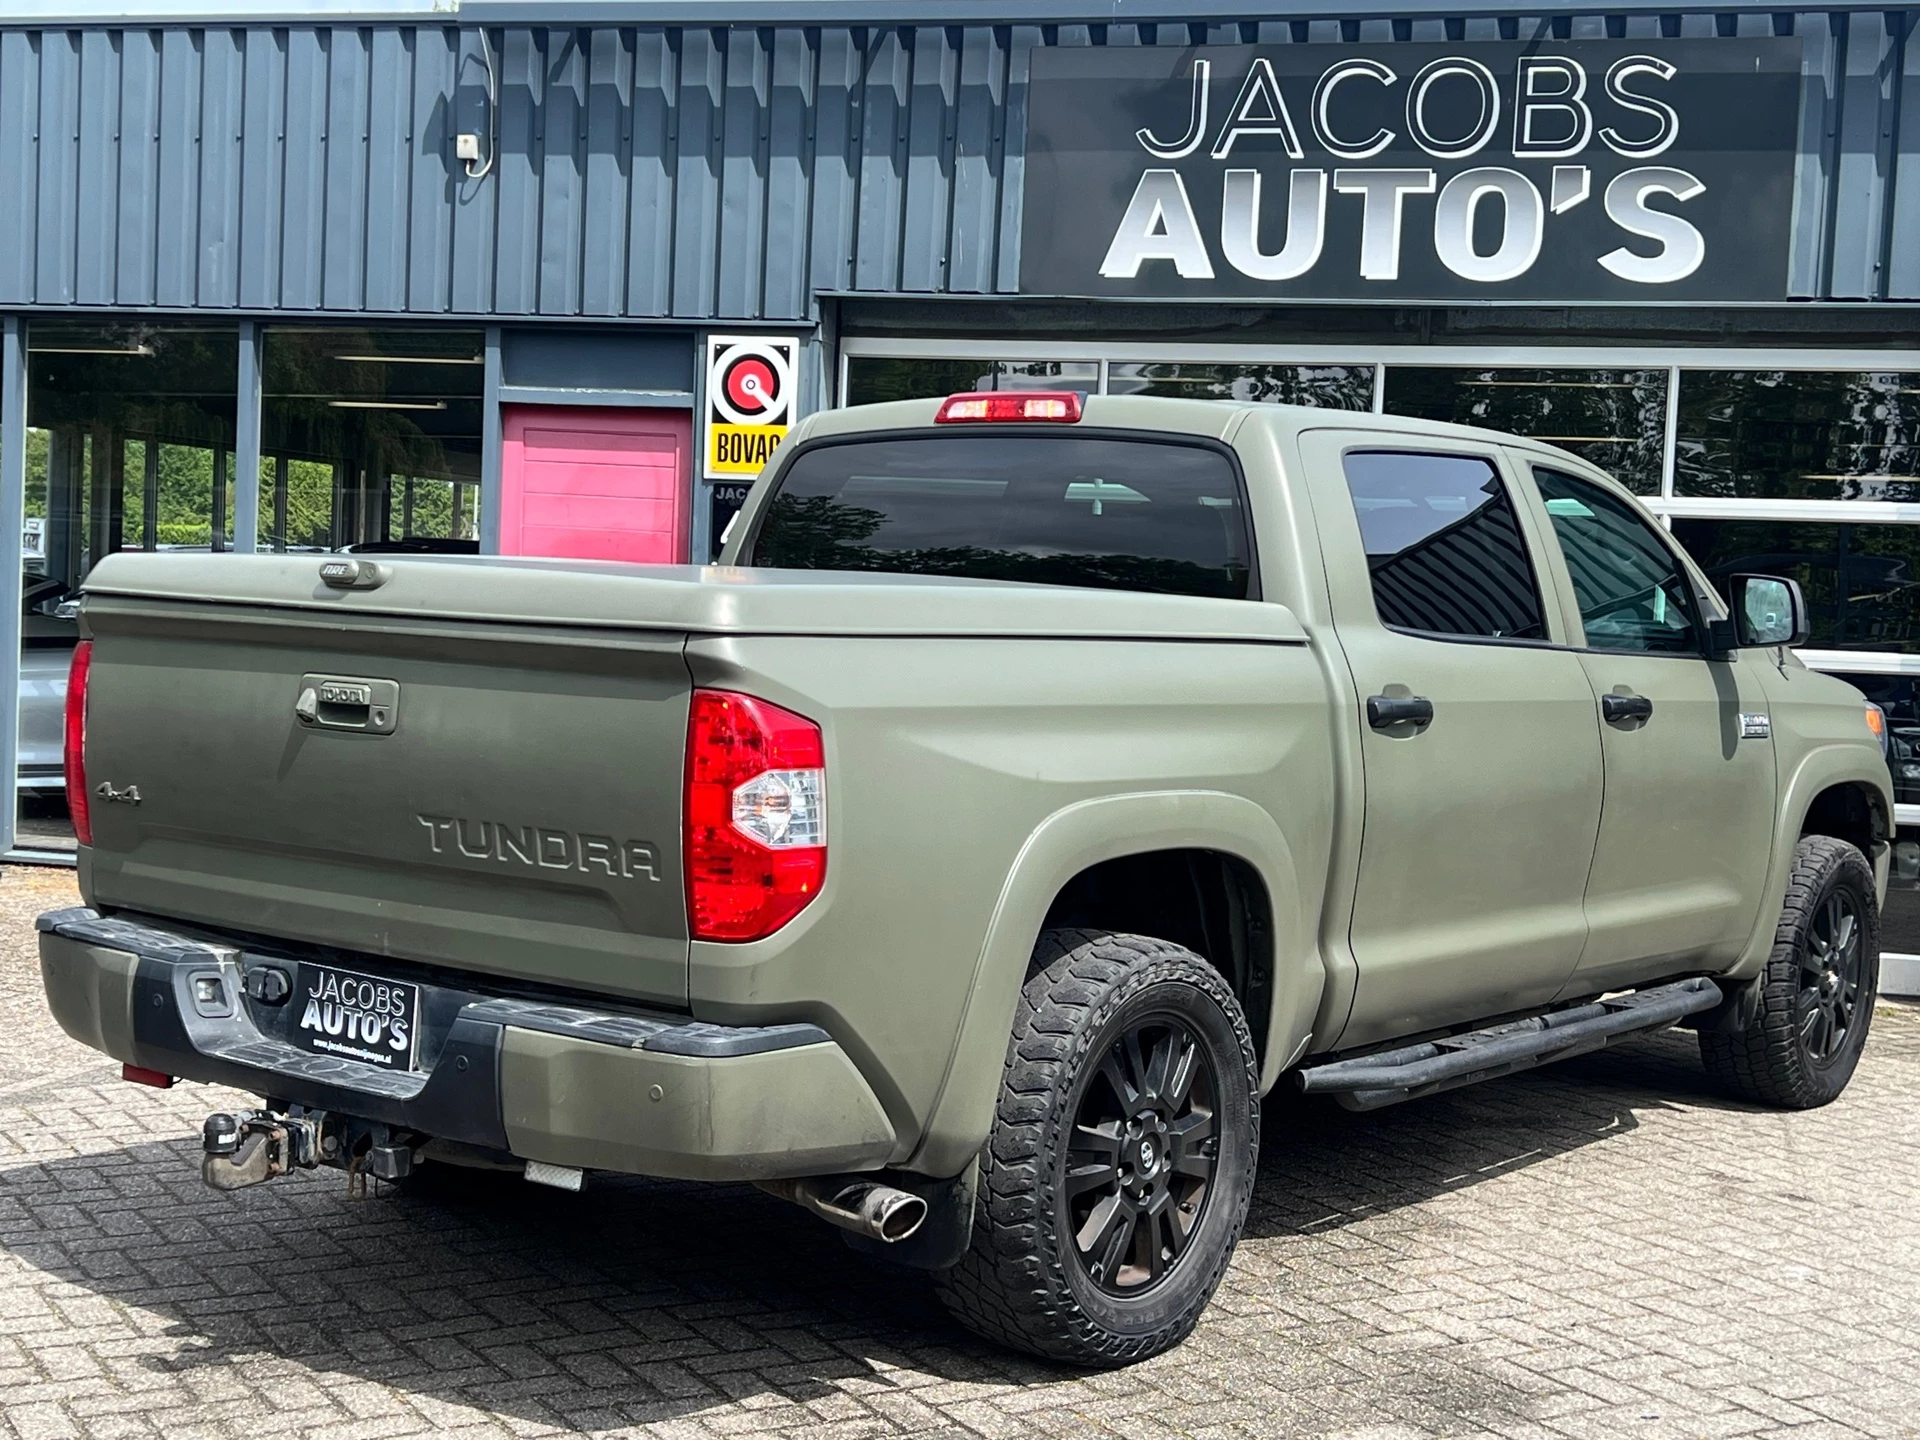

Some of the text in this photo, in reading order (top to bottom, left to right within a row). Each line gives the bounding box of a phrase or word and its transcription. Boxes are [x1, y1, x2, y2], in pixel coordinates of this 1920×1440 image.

[1136, 54, 1680, 160] JACOBS
[1098, 165, 1706, 284] AUTO'S
[715, 487, 750, 500] JAC
[320, 686, 365, 703] TOYOTA
[416, 812, 662, 882] TUNDRA
[308, 971, 405, 1017] JACOBS
[300, 998, 409, 1051] AUTO'S
